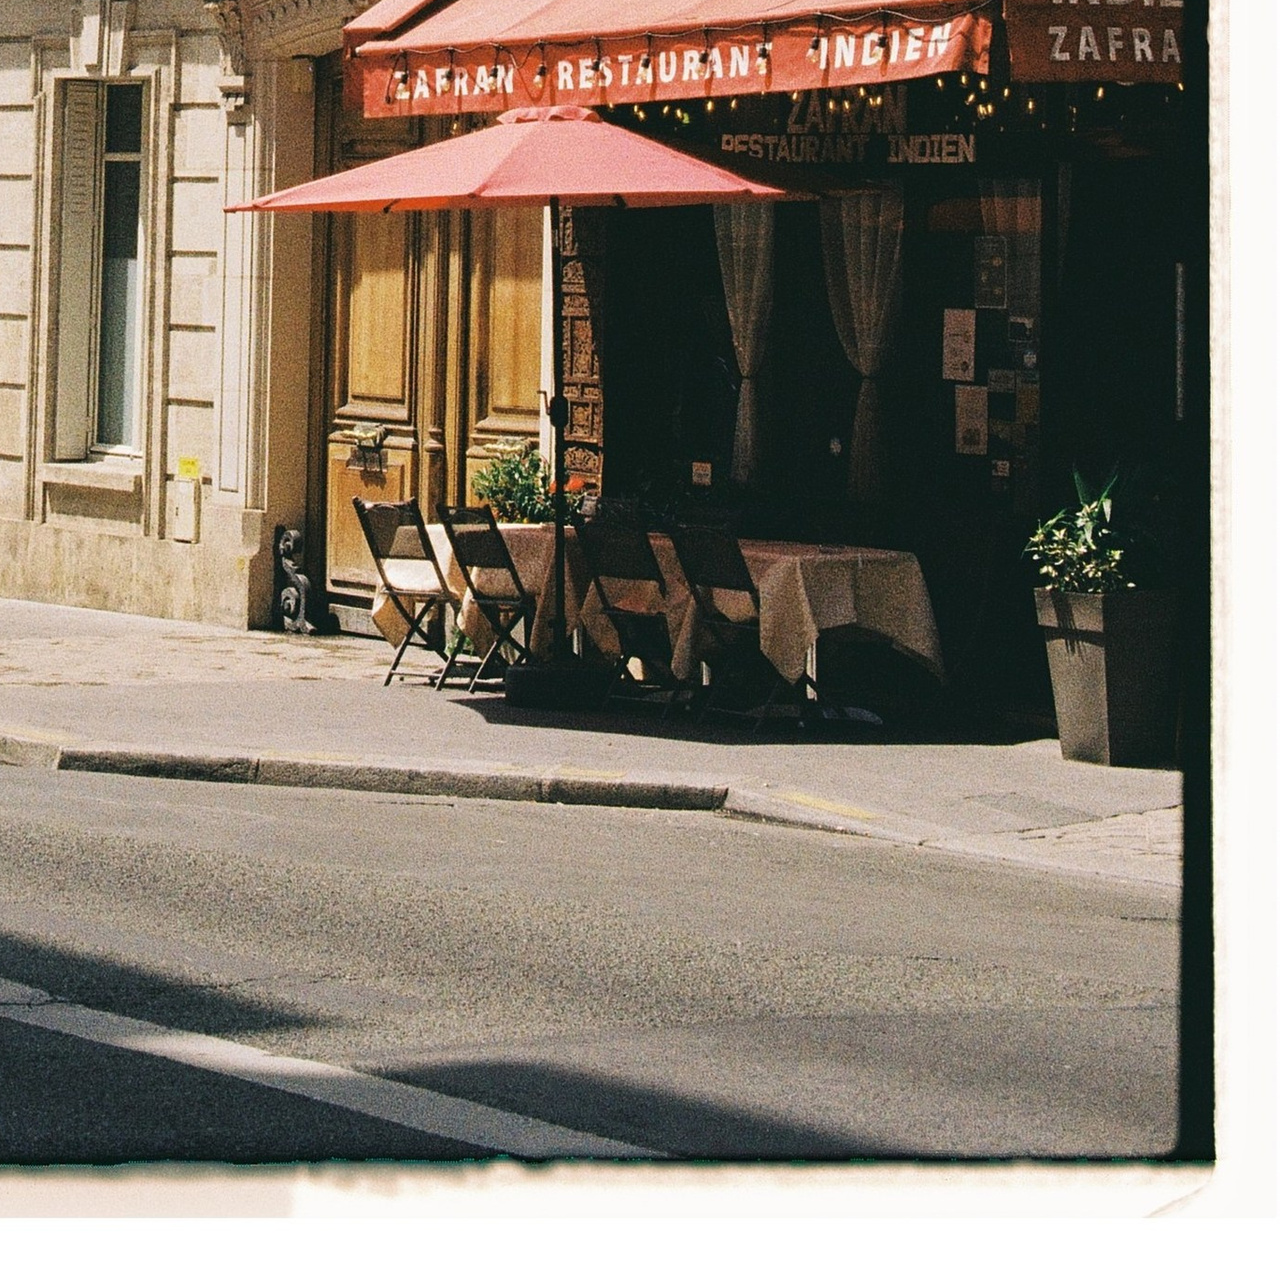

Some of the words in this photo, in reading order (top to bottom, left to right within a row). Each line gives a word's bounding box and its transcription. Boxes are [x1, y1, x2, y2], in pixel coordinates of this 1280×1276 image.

[394, 63, 514, 100] ZAFRAN
[557, 42, 774, 90] RESTAURANT
[819, 22, 952, 70] INDIEN
[1048, 25, 1182, 64] ZAFRA
[787, 85, 908, 135] ZAFRAN
[887, 133, 976, 164] INDIEN
